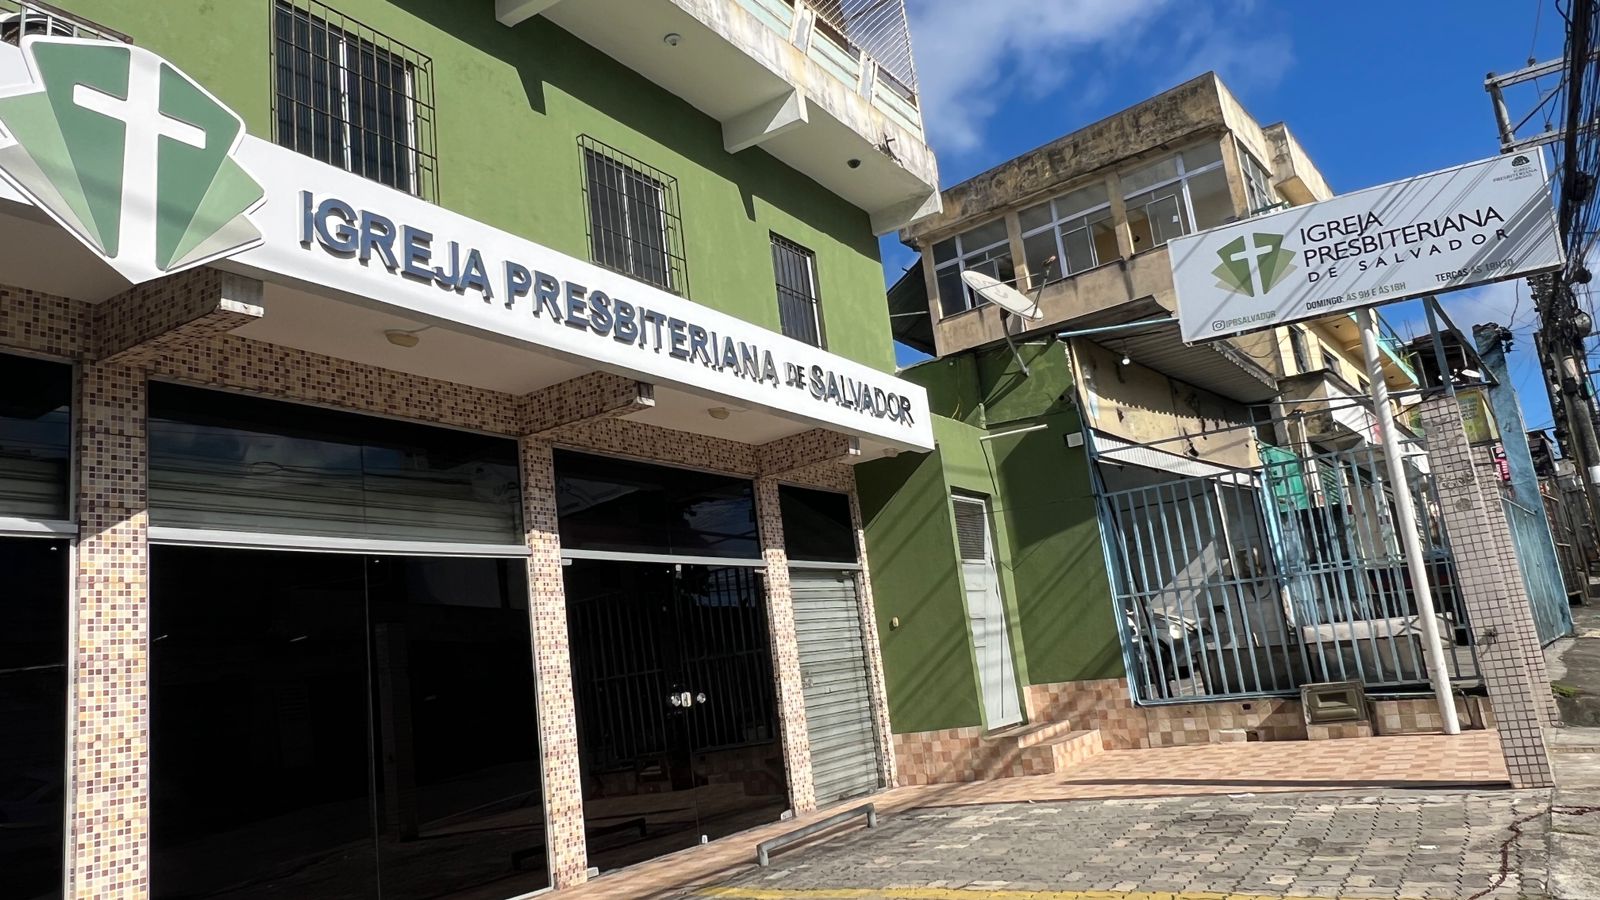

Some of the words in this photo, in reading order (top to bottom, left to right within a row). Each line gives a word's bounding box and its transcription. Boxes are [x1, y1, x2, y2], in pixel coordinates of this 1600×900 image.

[1300, 211, 1384, 245] IGREJA
[1303, 206, 1505, 267] PRESBITERIANA
[1308, 267, 1338, 283] DE
[1359, 228, 1509, 271] SALVADOR
[299, 190, 494, 304] IGREJA
[503, 260, 780, 388] PRESBITERIANA
[784, 361, 807, 390] DE
[808, 364, 915, 427] SALVADOR
[1359, 290, 1370, 299] 9H
[1371, 288, 1377, 296] E
